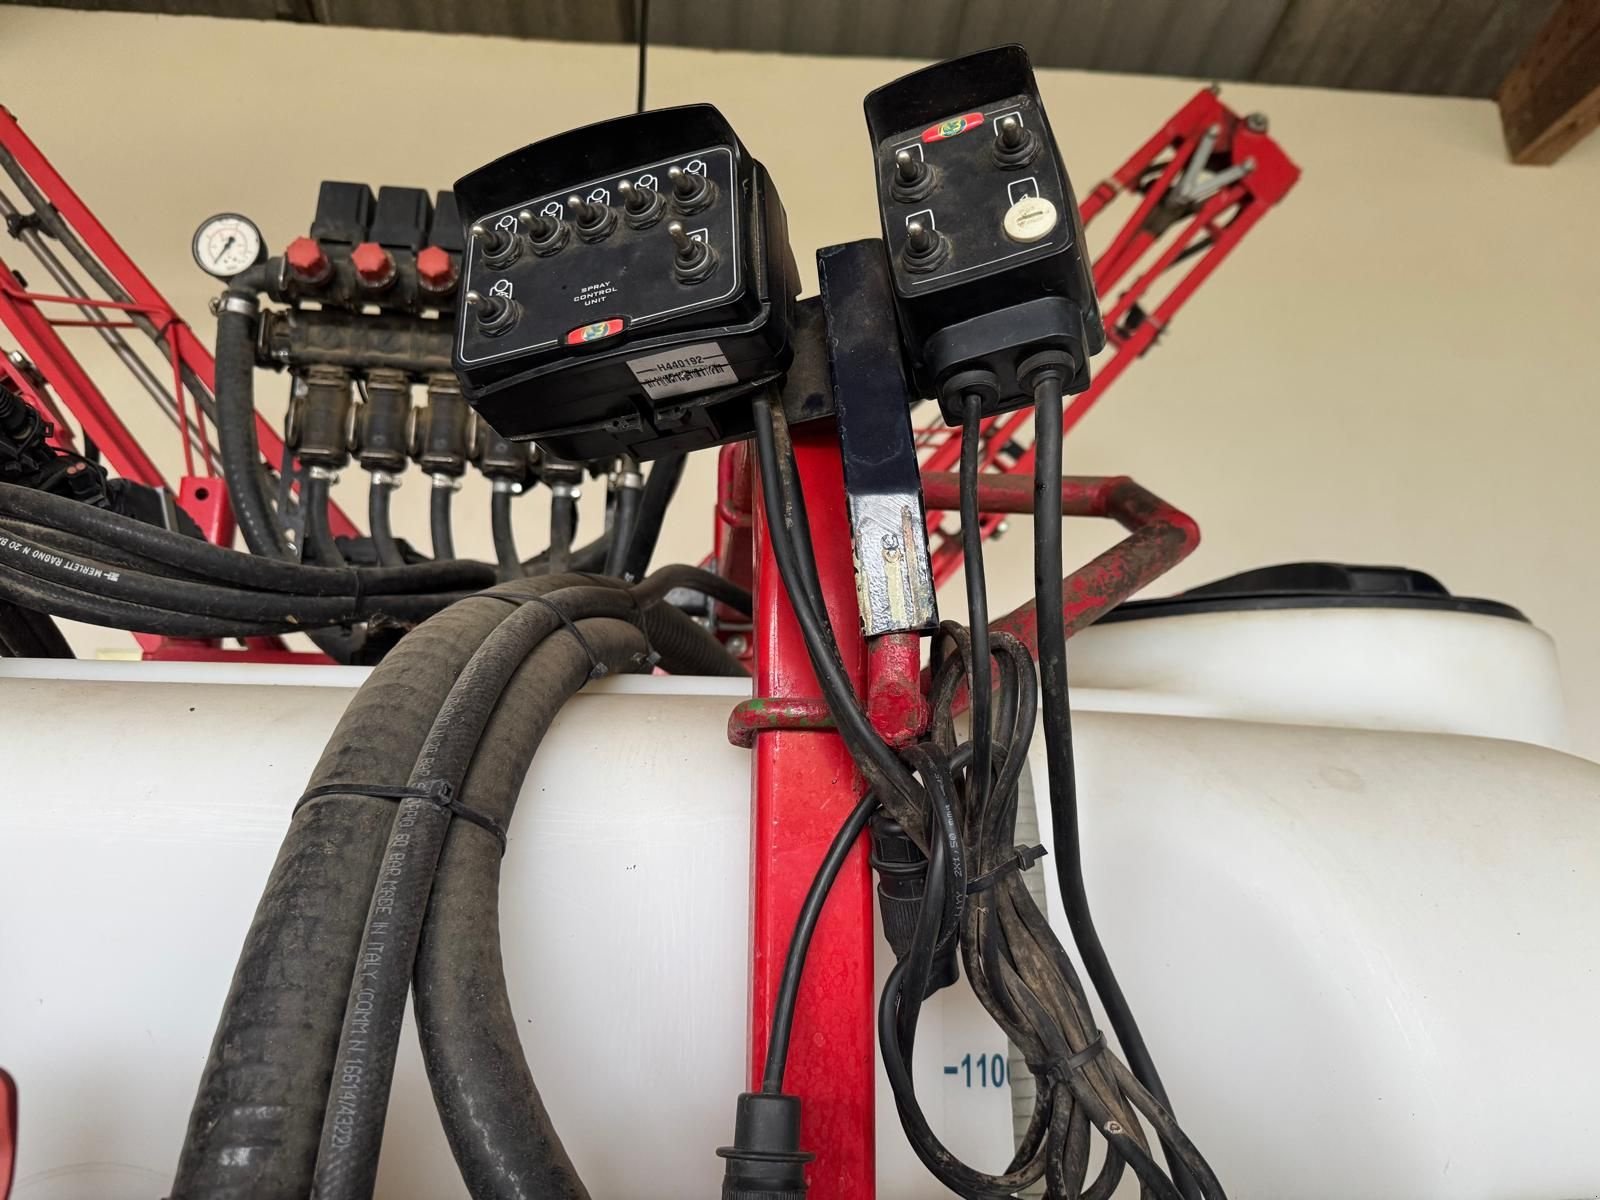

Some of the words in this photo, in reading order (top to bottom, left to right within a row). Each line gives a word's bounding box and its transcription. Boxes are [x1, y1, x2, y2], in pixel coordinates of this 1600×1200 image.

[573, 287, 618, 302] CONTROL
[581, 281, 611, 293] SPRAY
[584, 296, 607, 307] UNIT
[656, 355, 705, 372] H440192
[8, 540, 22, 551] 20
[22, 546, 31, 555] N
[32, 550, 64, 567] RAGNO
[63, 560, 103, 578] MERLETT
[375, 879, 400, 915] MADE
[371, 921, 391, 936] IN
[359, 941, 385, 980] ITALY
